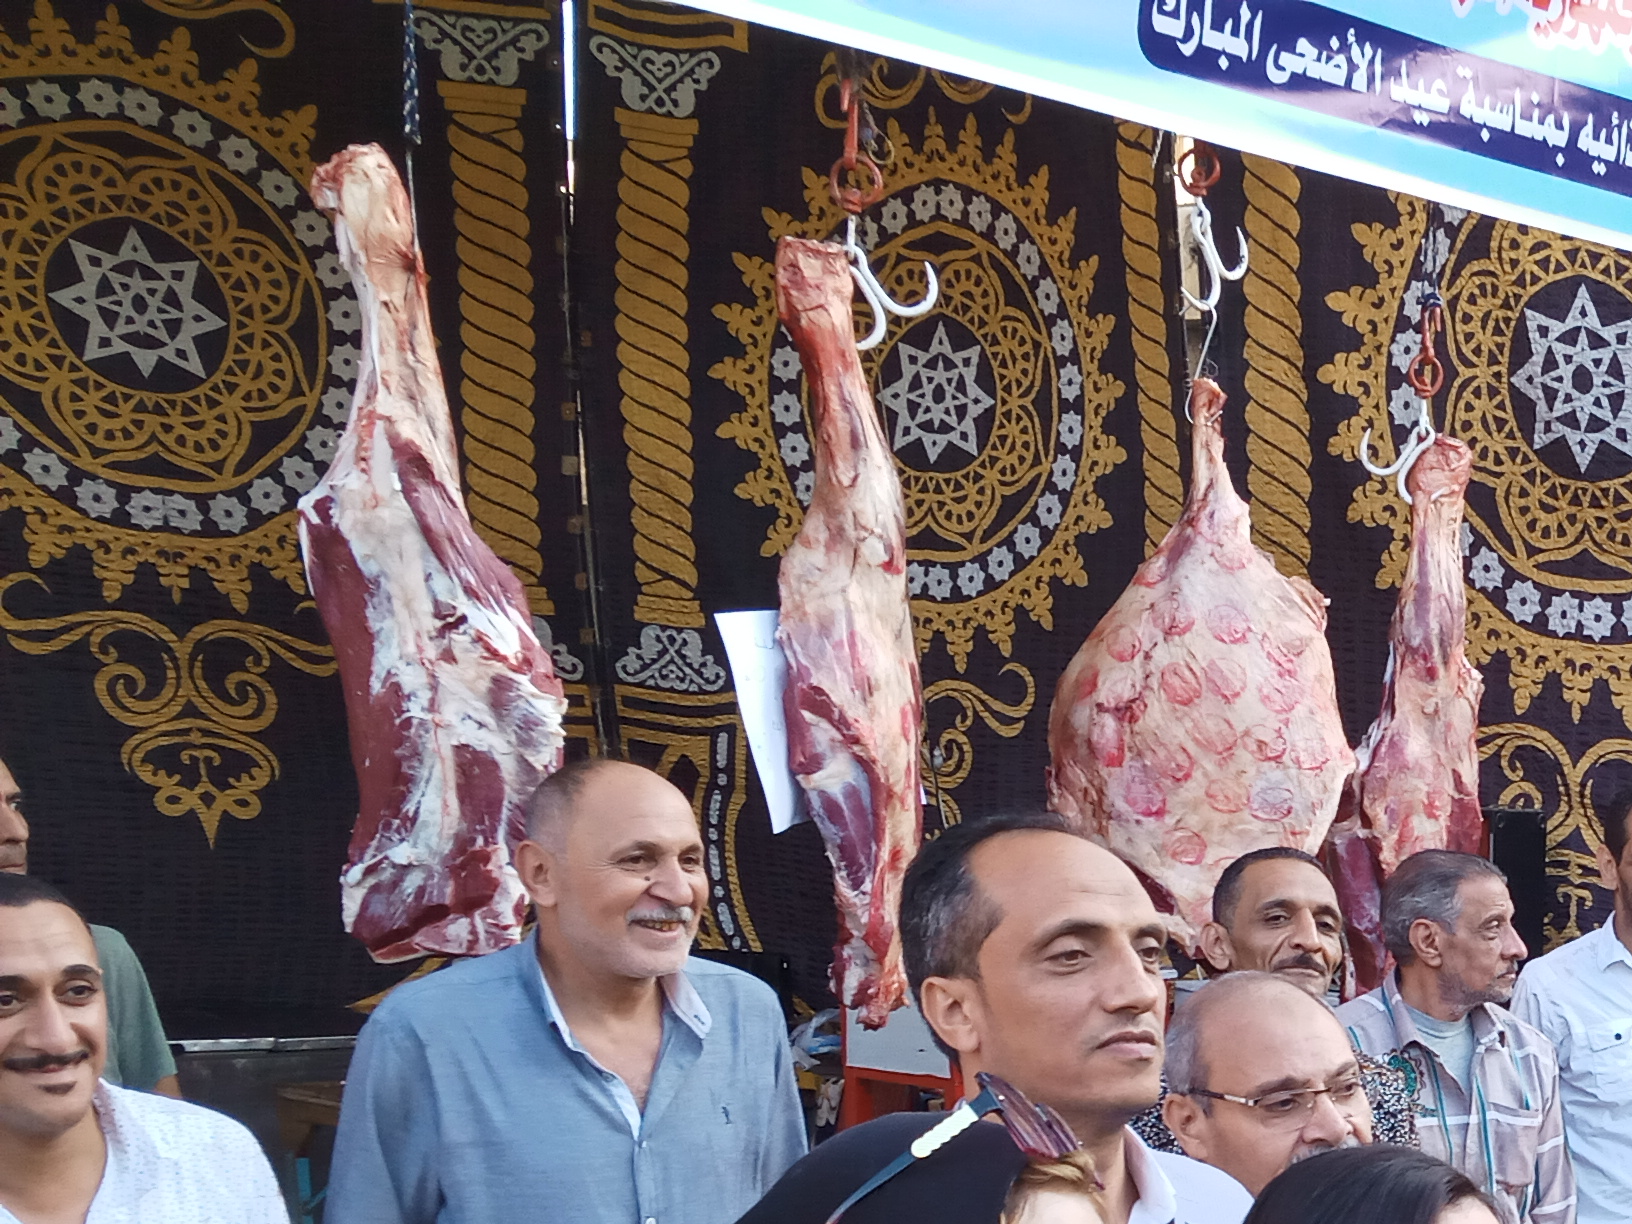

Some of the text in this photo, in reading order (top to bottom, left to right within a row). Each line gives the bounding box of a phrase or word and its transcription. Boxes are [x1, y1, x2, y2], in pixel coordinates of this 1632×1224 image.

[1151, 0, 1263, 71] المبارك
[1266, 27, 1382, 96] الأضحى
[1390, 58, 1451, 127] عيد
[1459, 64, 1570, 168] بمناسبة
